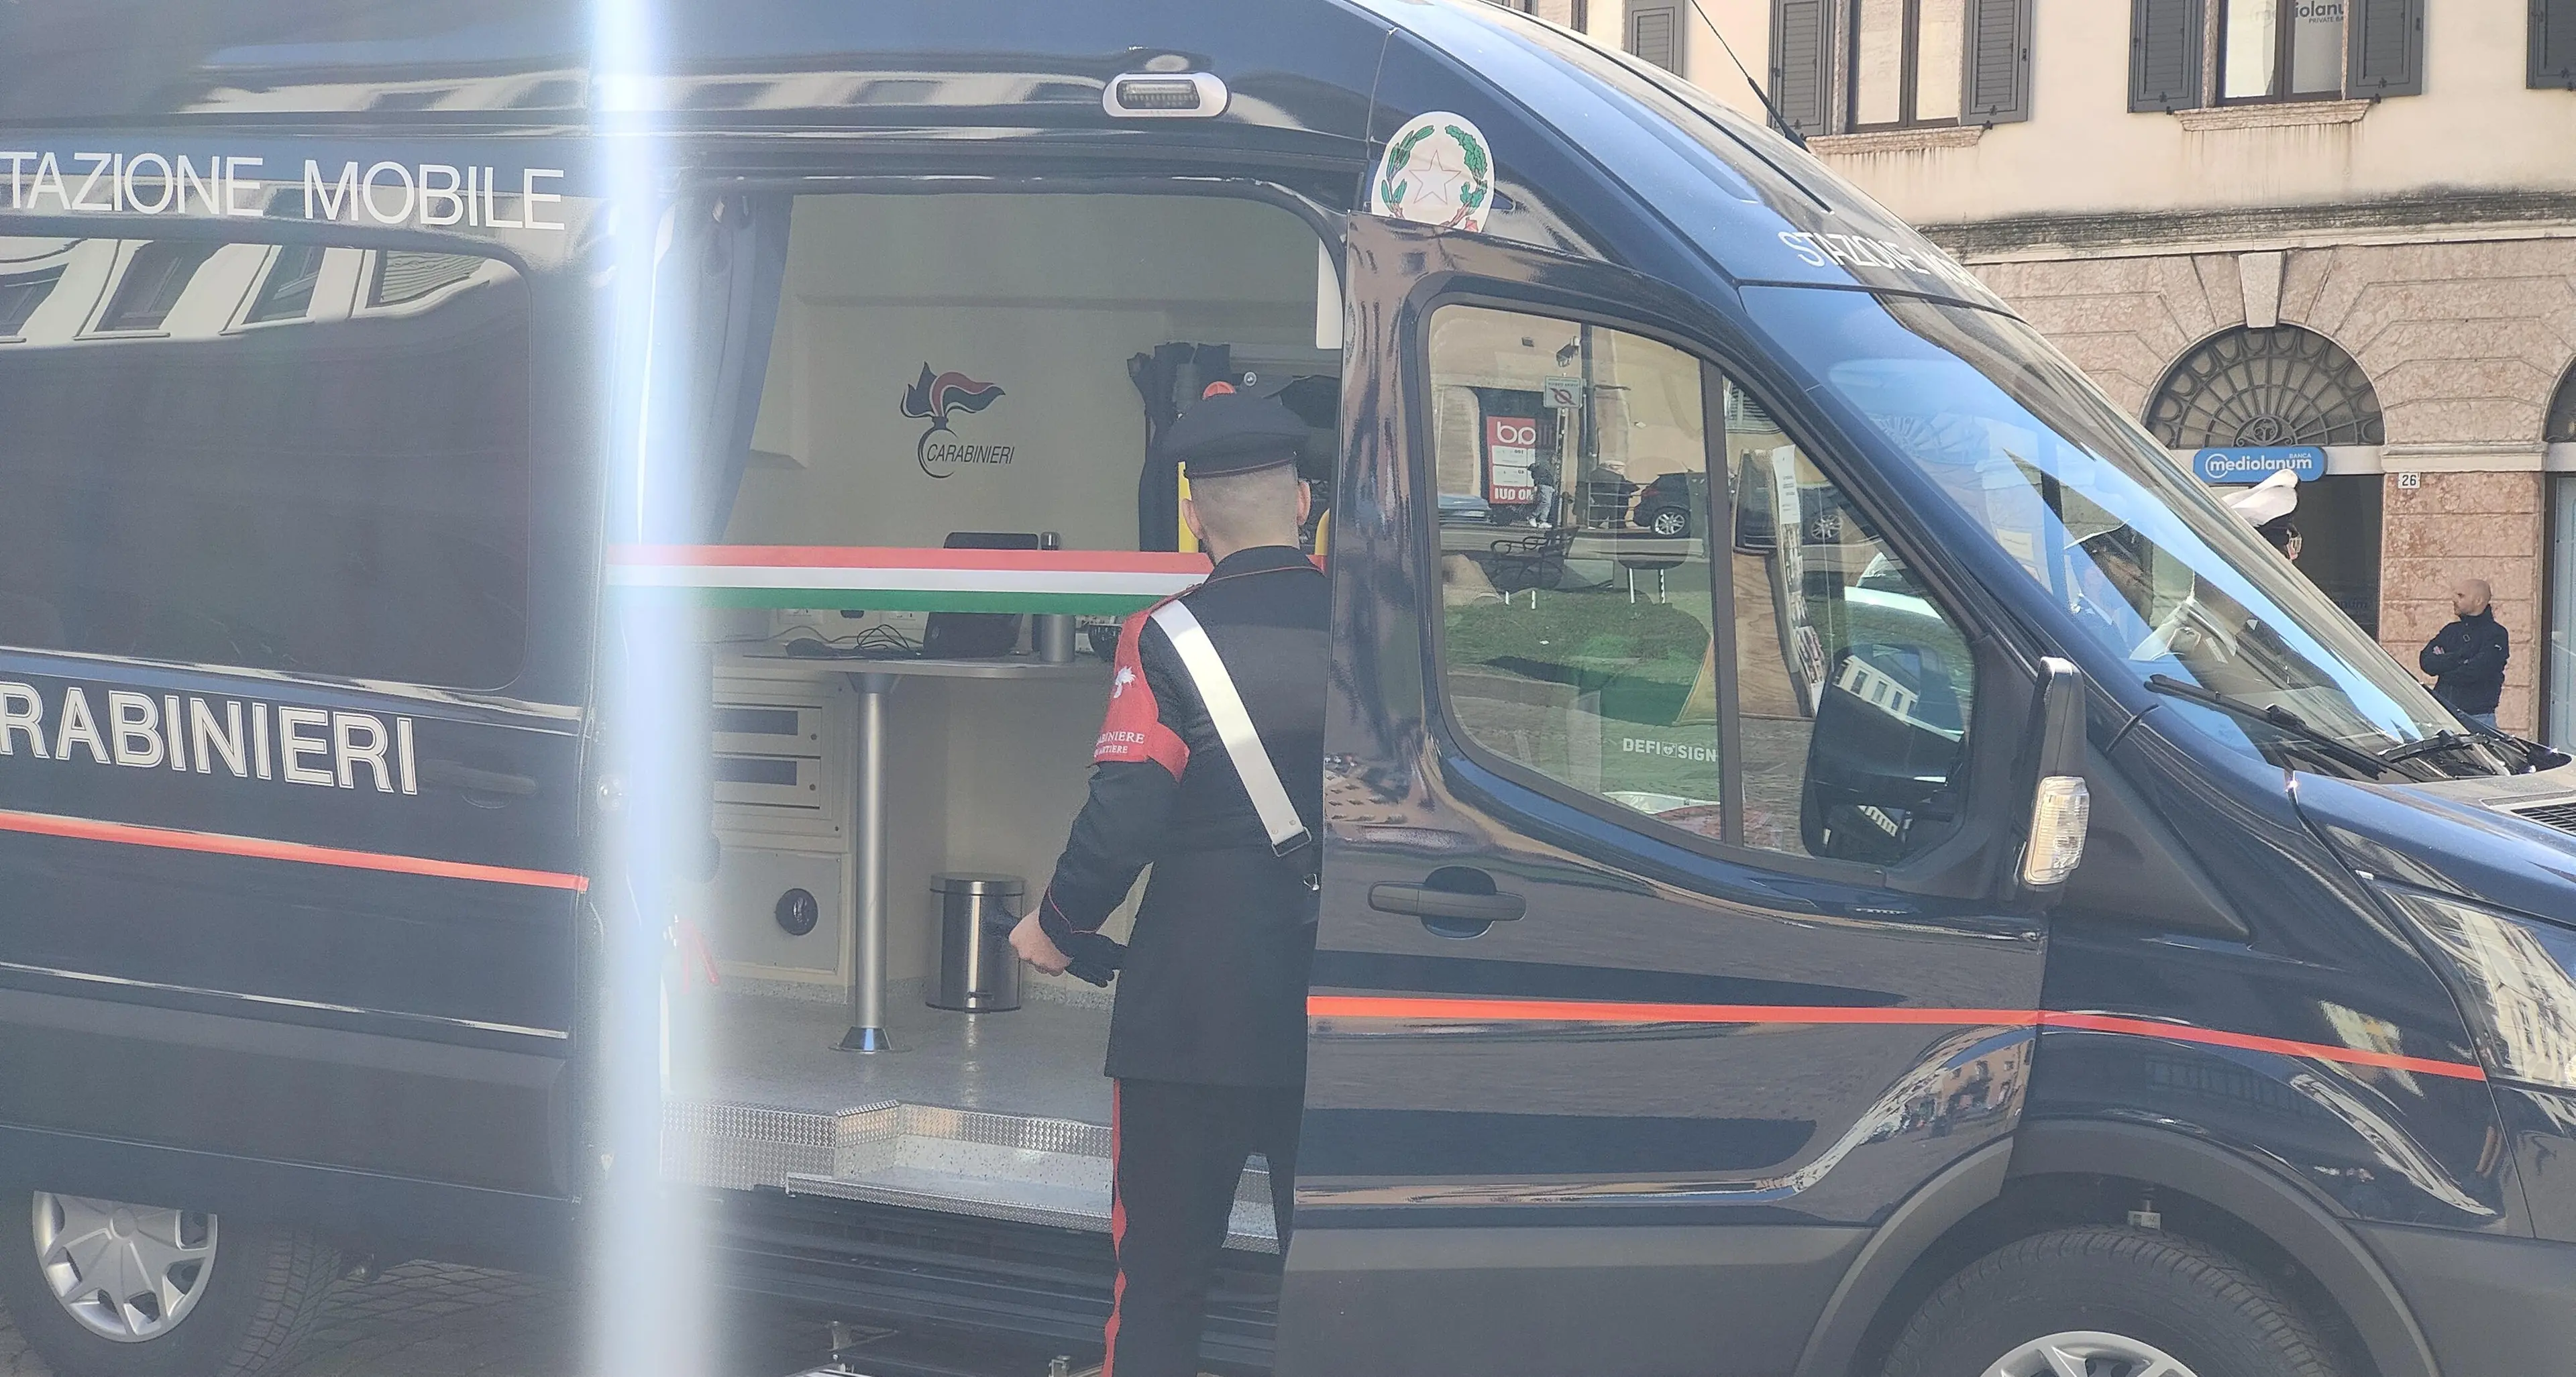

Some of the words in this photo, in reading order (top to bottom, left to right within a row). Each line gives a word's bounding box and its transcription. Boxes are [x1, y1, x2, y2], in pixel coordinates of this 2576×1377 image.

[0, 152, 264, 217] TAZIONE
[304, 159, 566, 231] MOBILE
[926, 443, 1015, 465] CARABINIERI
[2207, 455, 2312, 473] mediolanum
[2402, 474, 2417, 486] 26
[0, 681, 418, 795] RABINIERI
[1623, 737, 1660, 755] DEFI
[1678, 745, 1717, 762] SIGN
